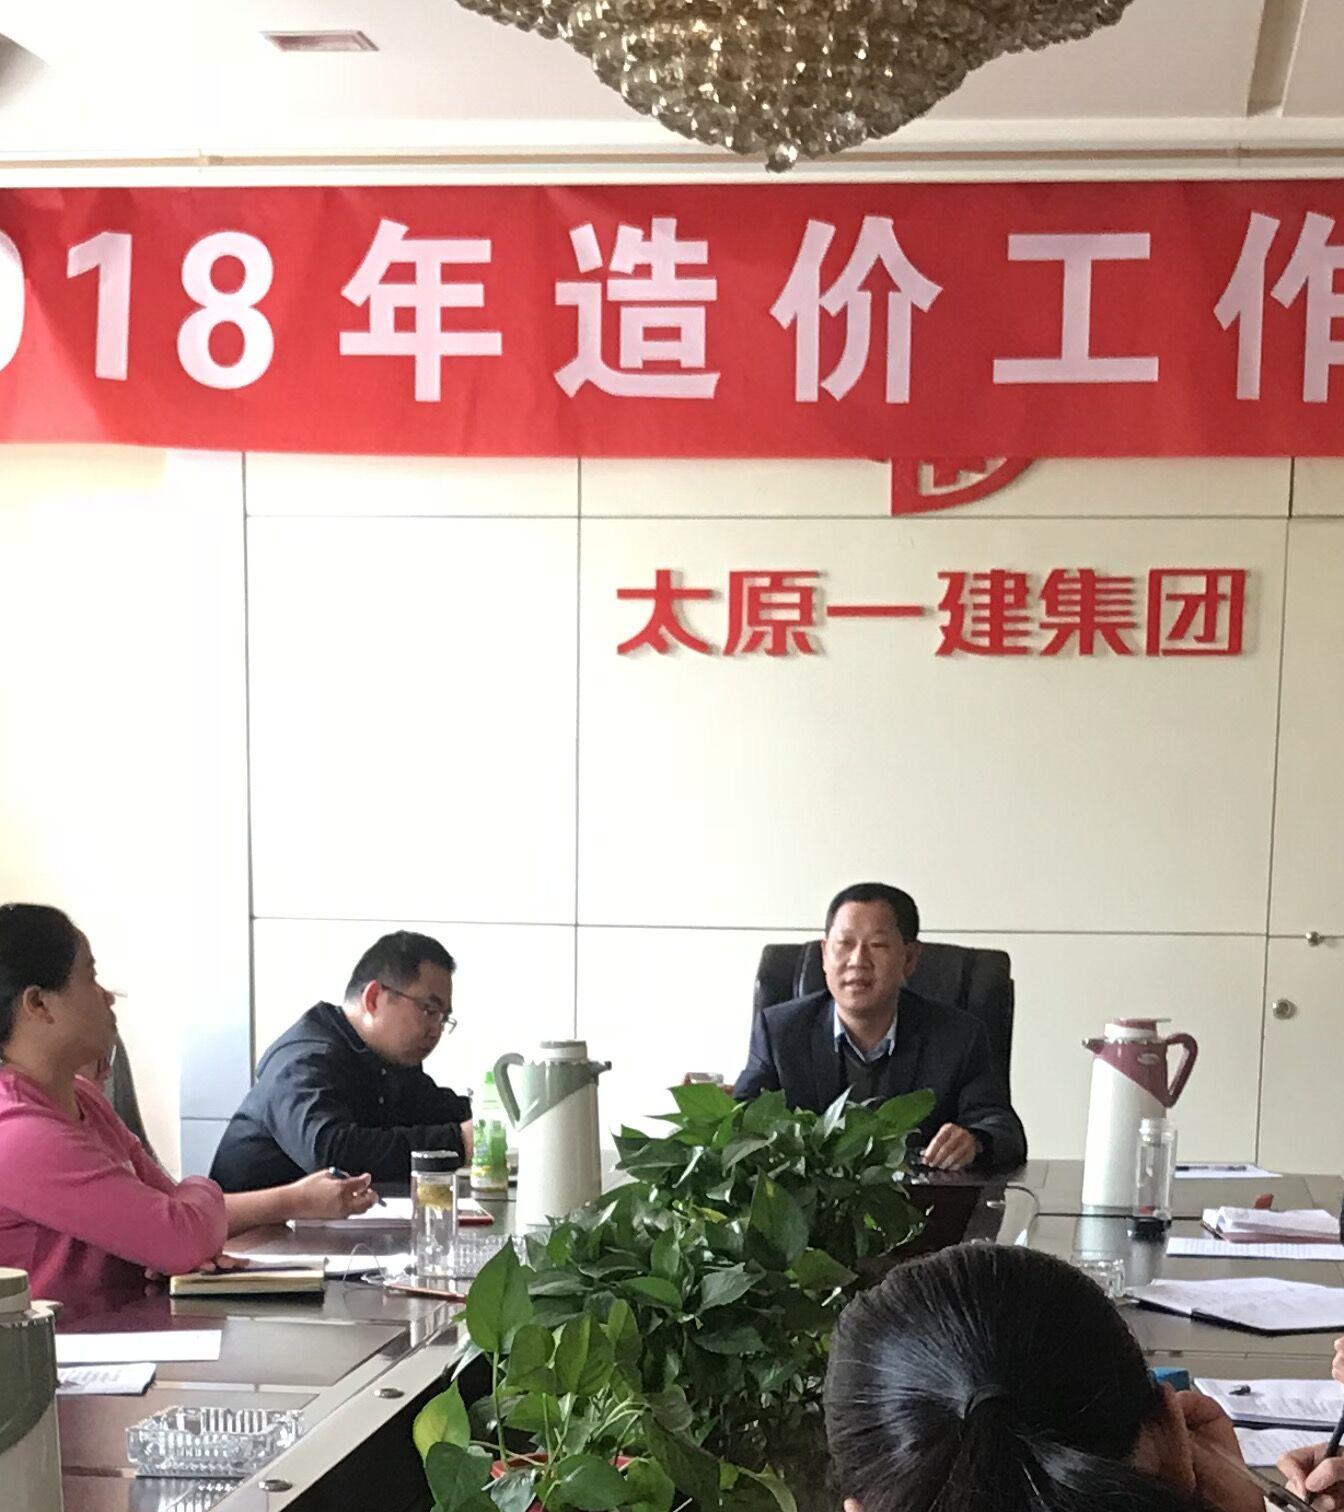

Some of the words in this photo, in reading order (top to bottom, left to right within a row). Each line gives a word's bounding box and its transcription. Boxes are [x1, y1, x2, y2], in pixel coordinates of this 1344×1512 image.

[616, 568, 1247, 656] 太原一建集团
